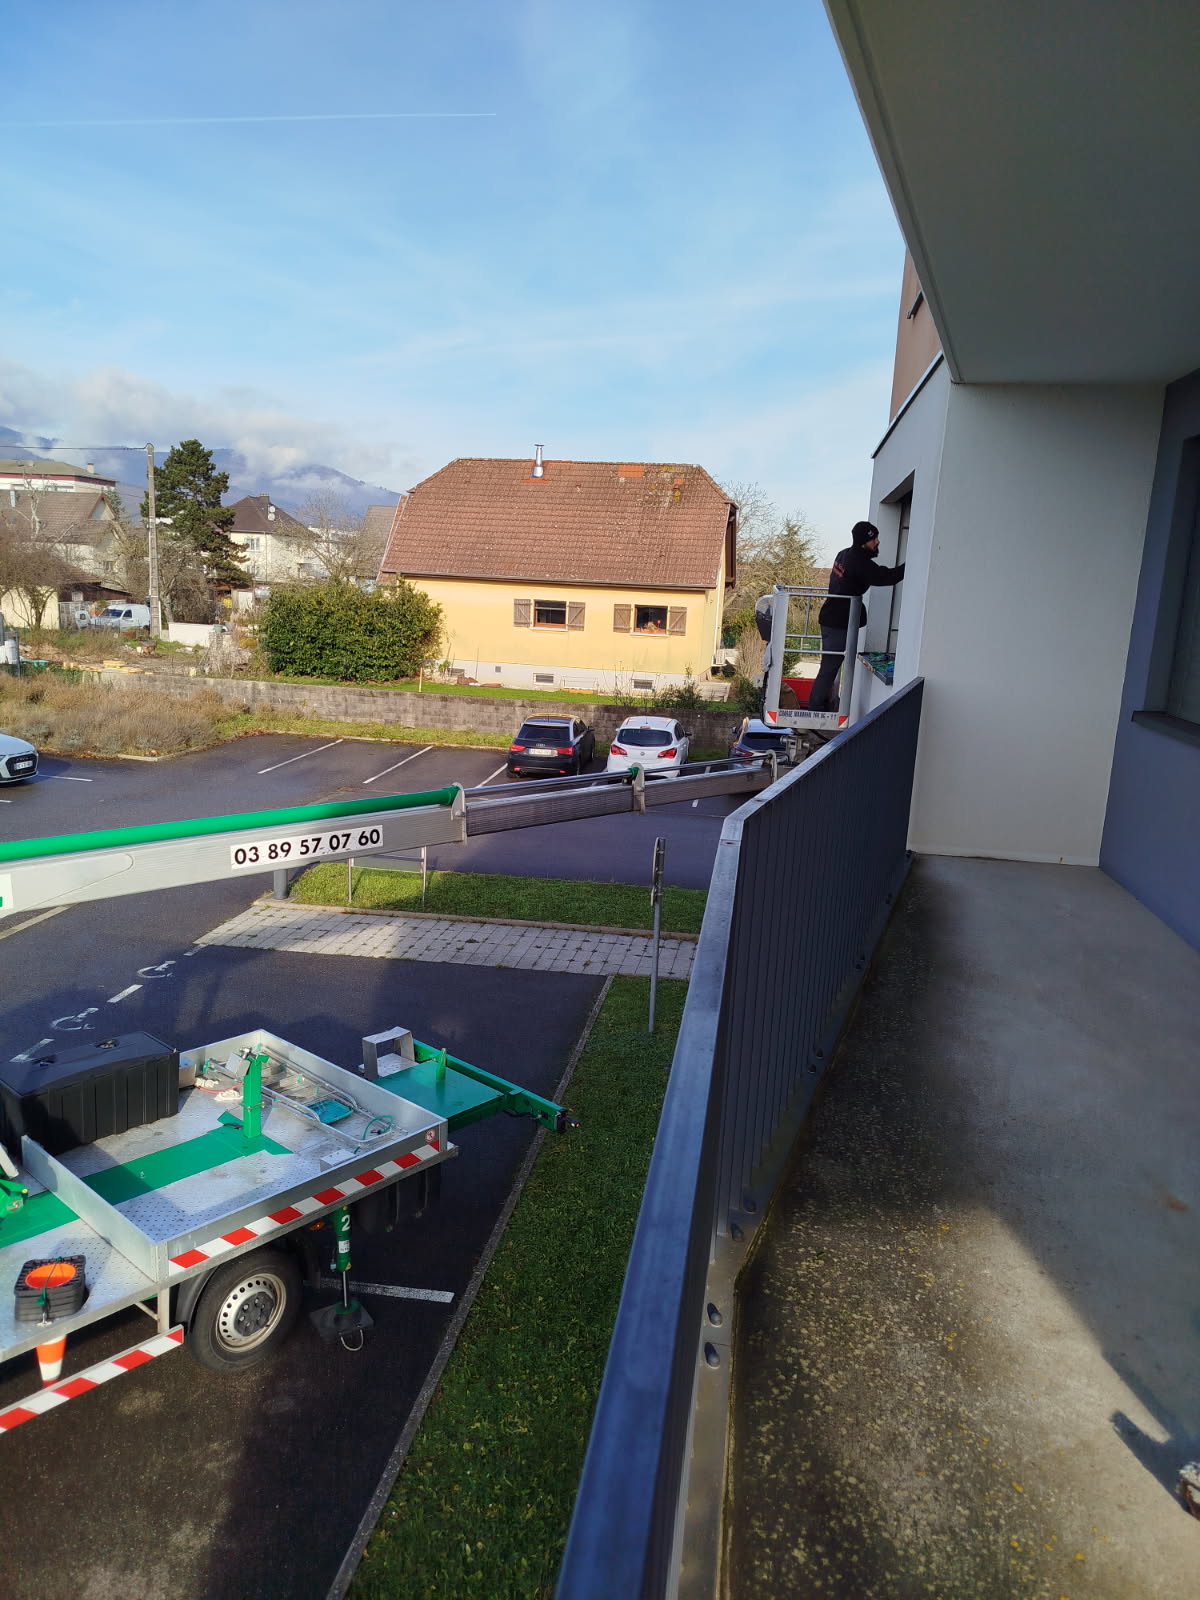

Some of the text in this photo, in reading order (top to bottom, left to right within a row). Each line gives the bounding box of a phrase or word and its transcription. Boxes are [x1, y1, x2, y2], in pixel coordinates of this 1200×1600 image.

[234, 829, 380, 865] 03 89 57 07 60
[341, 1214, 351, 1232] 2
